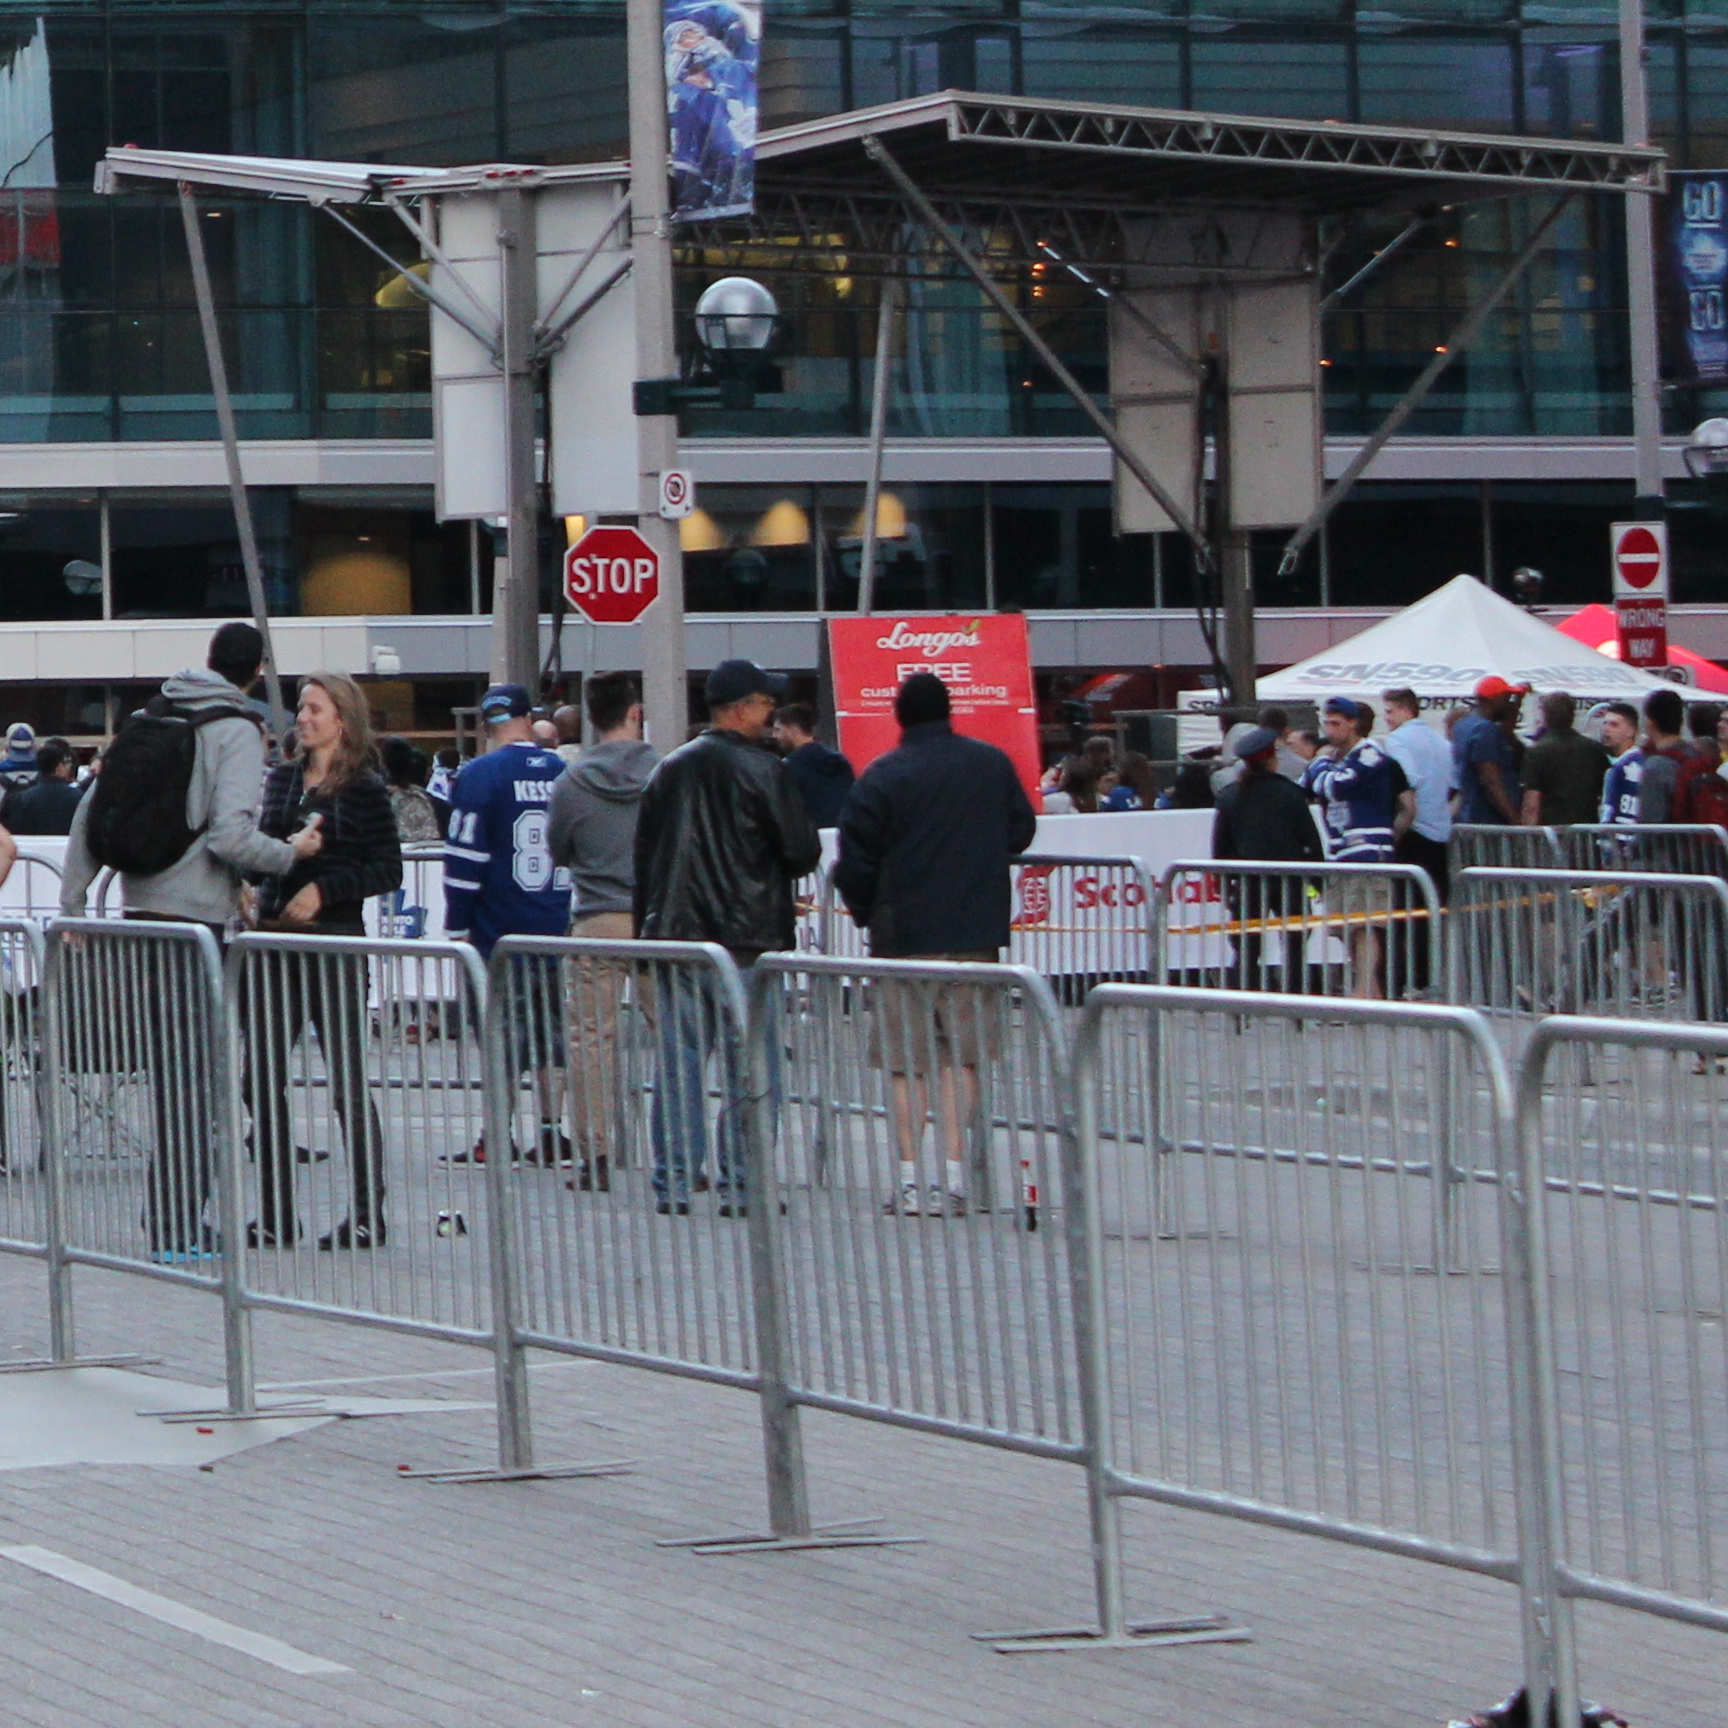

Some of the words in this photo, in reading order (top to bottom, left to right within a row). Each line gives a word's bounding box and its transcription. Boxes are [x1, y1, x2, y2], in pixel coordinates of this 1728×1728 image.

[1683, 181, 1722, 221] GO
[1690, 290, 1724, 331] GO
[570, 555, 655, 595] STOP
[1618, 607, 1666, 628] WRONG
[1627, 638, 1657, 659] WAY
